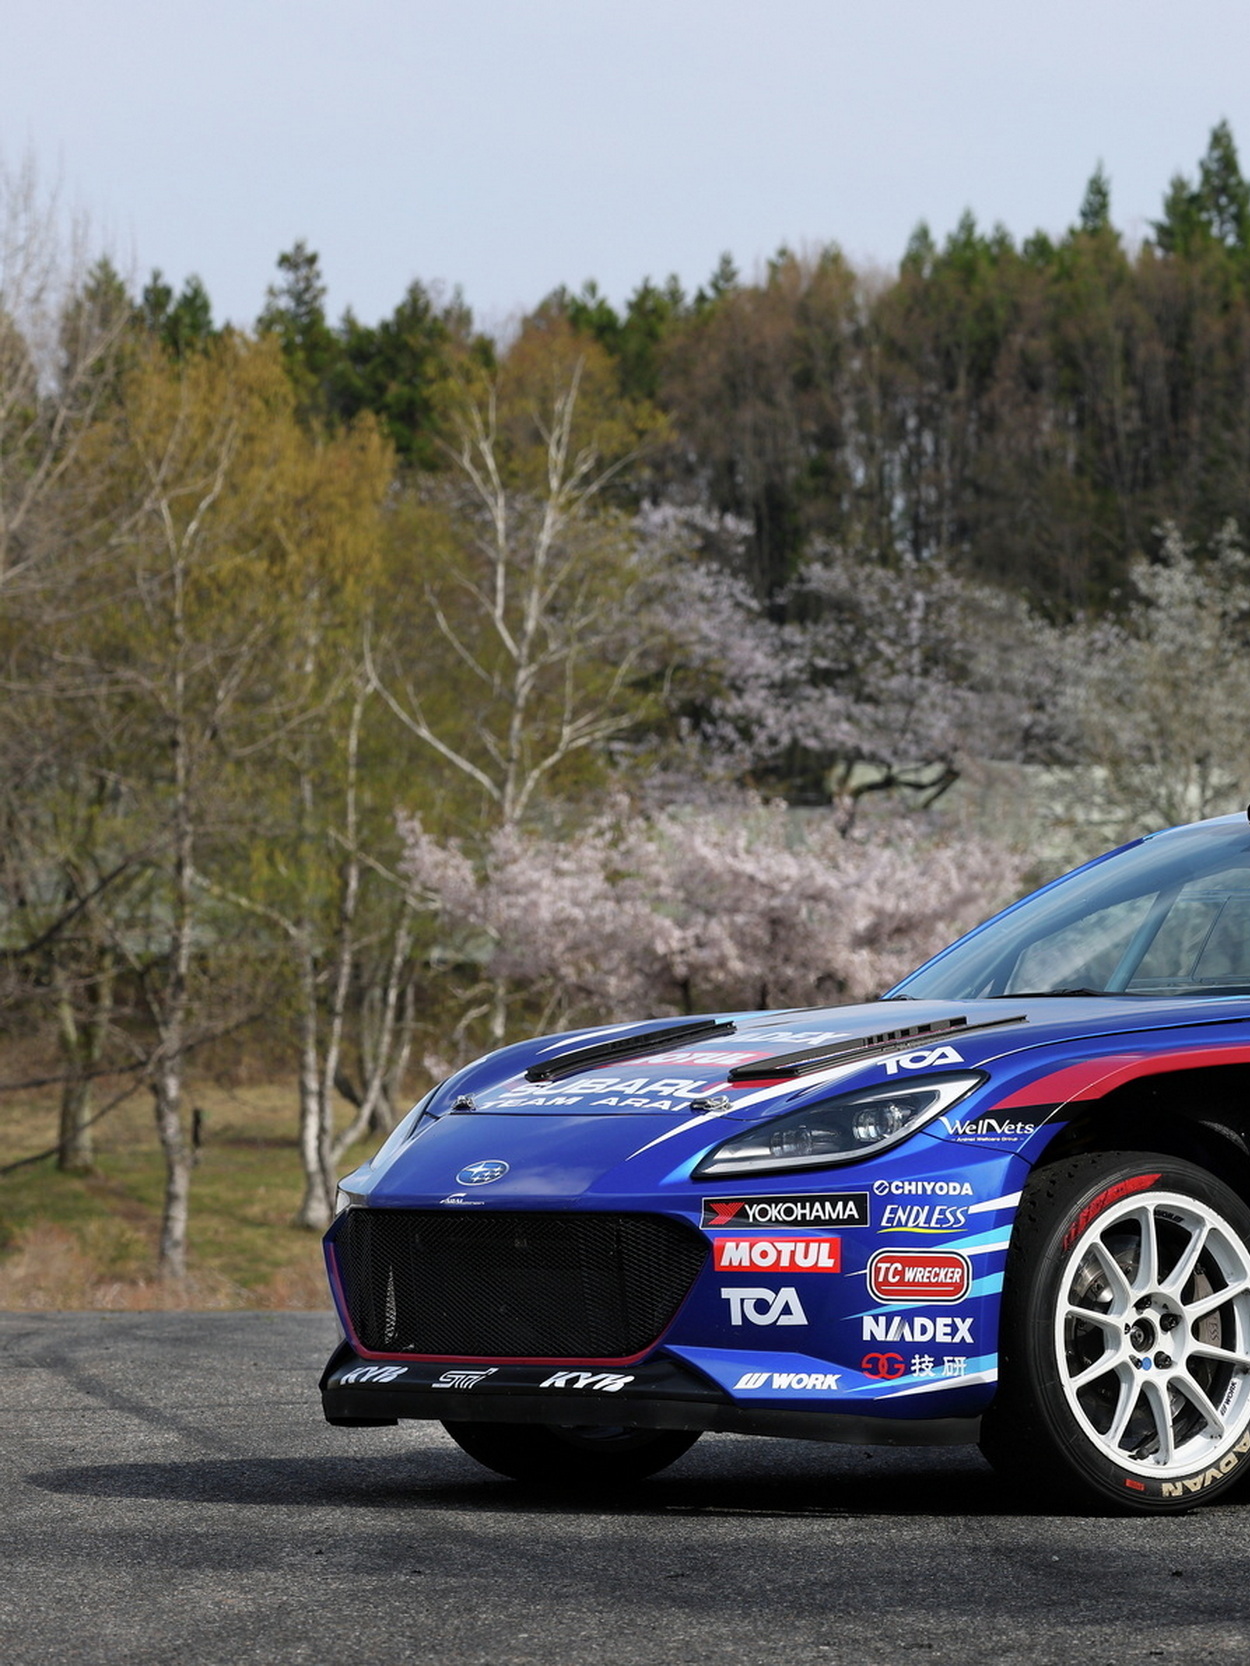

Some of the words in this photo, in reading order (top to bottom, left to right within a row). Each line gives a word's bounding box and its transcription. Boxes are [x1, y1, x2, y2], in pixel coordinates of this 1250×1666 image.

[877, 1045, 965, 1075] TOA
[499, 1078, 732, 1099] SUBARU
[477, 1096, 584, 1111] TEAM
[589, 1097, 692, 1114] ARAI
[891, 1181, 973, 1195] CHIYODA
[744, 1201, 859, 1221] YOKOHAMA
[880, 1204, 968, 1228] ENDLESS
[720, 1241, 835, 1267] MOTUL
[877, 1263, 903, 1283] TC
[904, 1267, 962, 1284] WRECKER
[721, 1287, 809, 1326] TOA
[863, 1316, 974, 1343] NADEX
[539, 1371, 635, 1392] KYB
[771, 1373, 842, 1390] WORK
